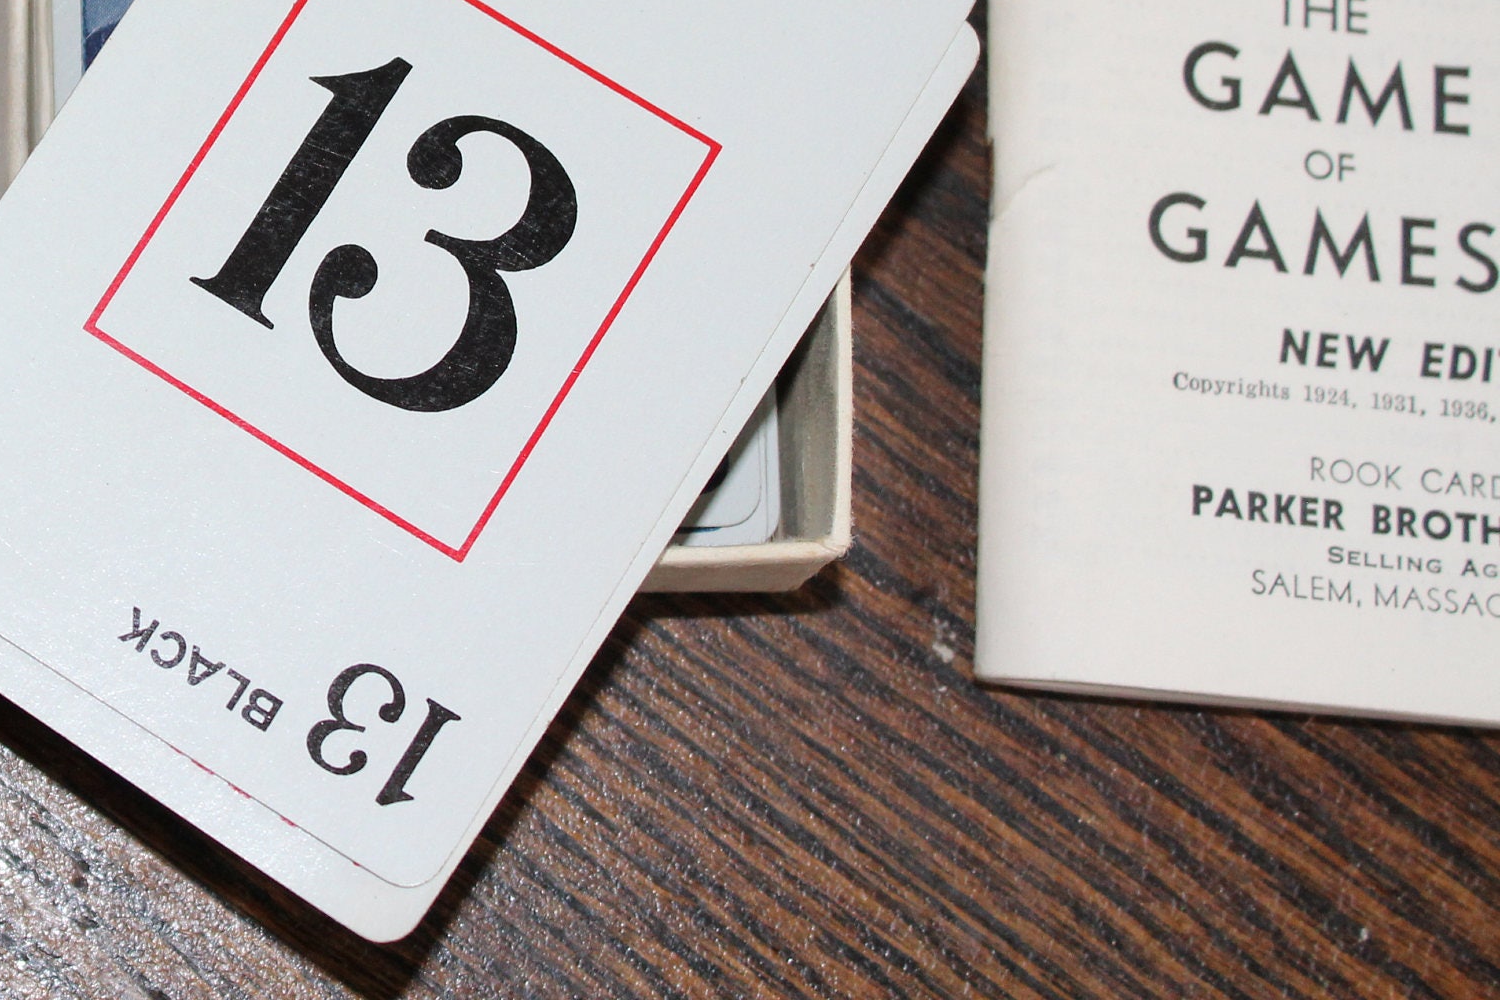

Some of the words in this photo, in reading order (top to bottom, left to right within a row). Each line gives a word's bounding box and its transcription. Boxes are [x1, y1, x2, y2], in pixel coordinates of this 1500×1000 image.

[1182, 40, 1471, 136] GAME
[1304, 149, 1357, 183] OF
[188, 55, 579, 414] 13
[1147, 191, 1500, 294] GAMES
[1278, 327, 1391, 373] NEW
[1419, 341, 1500, 384] EDI
[1172, 371, 1291, 400] Copyrights
[1303, 384, 1357, 409] 1924,
[1370, 391, 1427, 417] 1931,
[1439, 397, 1497, 424] 1936,
[1309, 456, 1402, 491] ROOK
[1190, 484, 1345, 532] PARKER
[1371, 503, 1500, 546] BROTH
[1250, 568, 1362, 609] SALEM,
[117, 605, 285, 733] BLACK
[305, 662, 462, 807] 13
